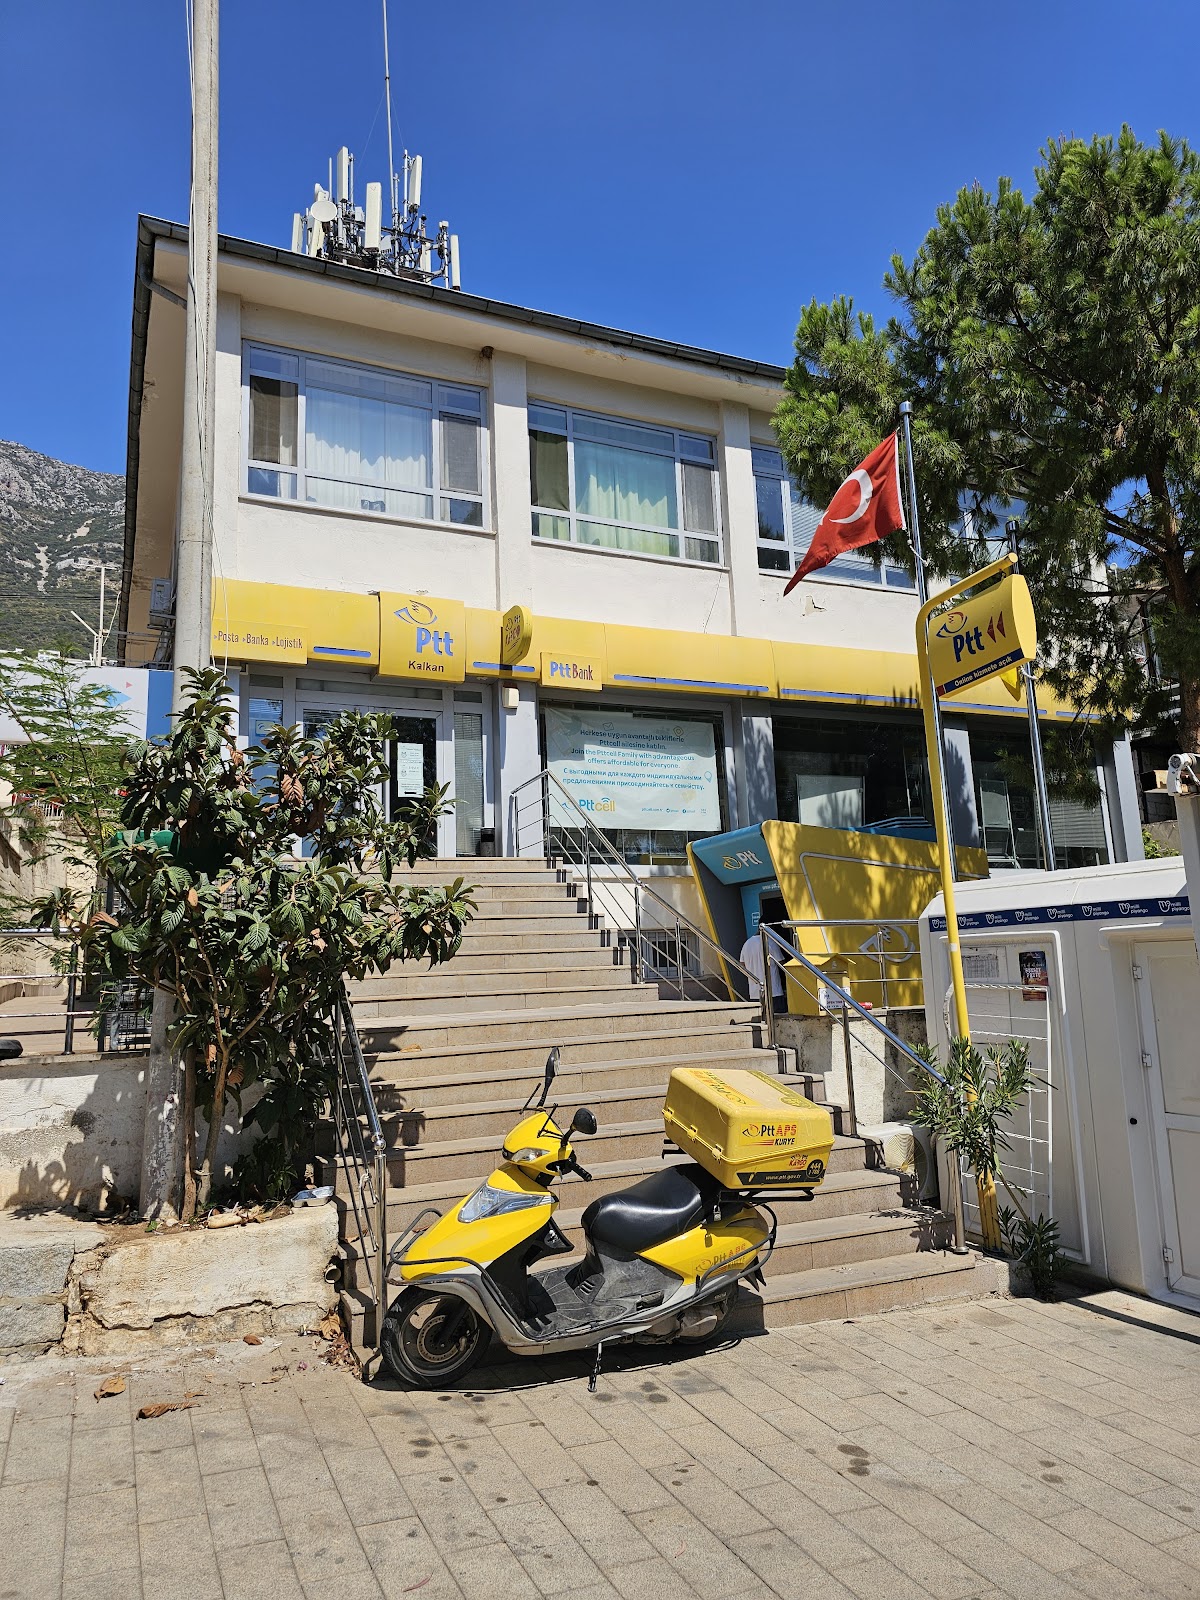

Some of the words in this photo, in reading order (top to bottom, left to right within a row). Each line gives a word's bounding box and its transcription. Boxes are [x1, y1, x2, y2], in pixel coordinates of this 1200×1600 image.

[218, 631, 239, 642] Posta
[246, 634, 269, 645] Banka
[276, 637, 303, 649] Lojistik
[416, 627, 454, 656] Ptt
[953, 626, 985, 663] Ptt
[408, 660, 444, 672] Kalkan
[955, 675, 973, 686] Online
[618, 751, 638, 759] Family
[579, 799, 615, 811] Pttcell
[736, 850, 763, 867] Ptt
[775, 1138, 796, 1146] KURYE
